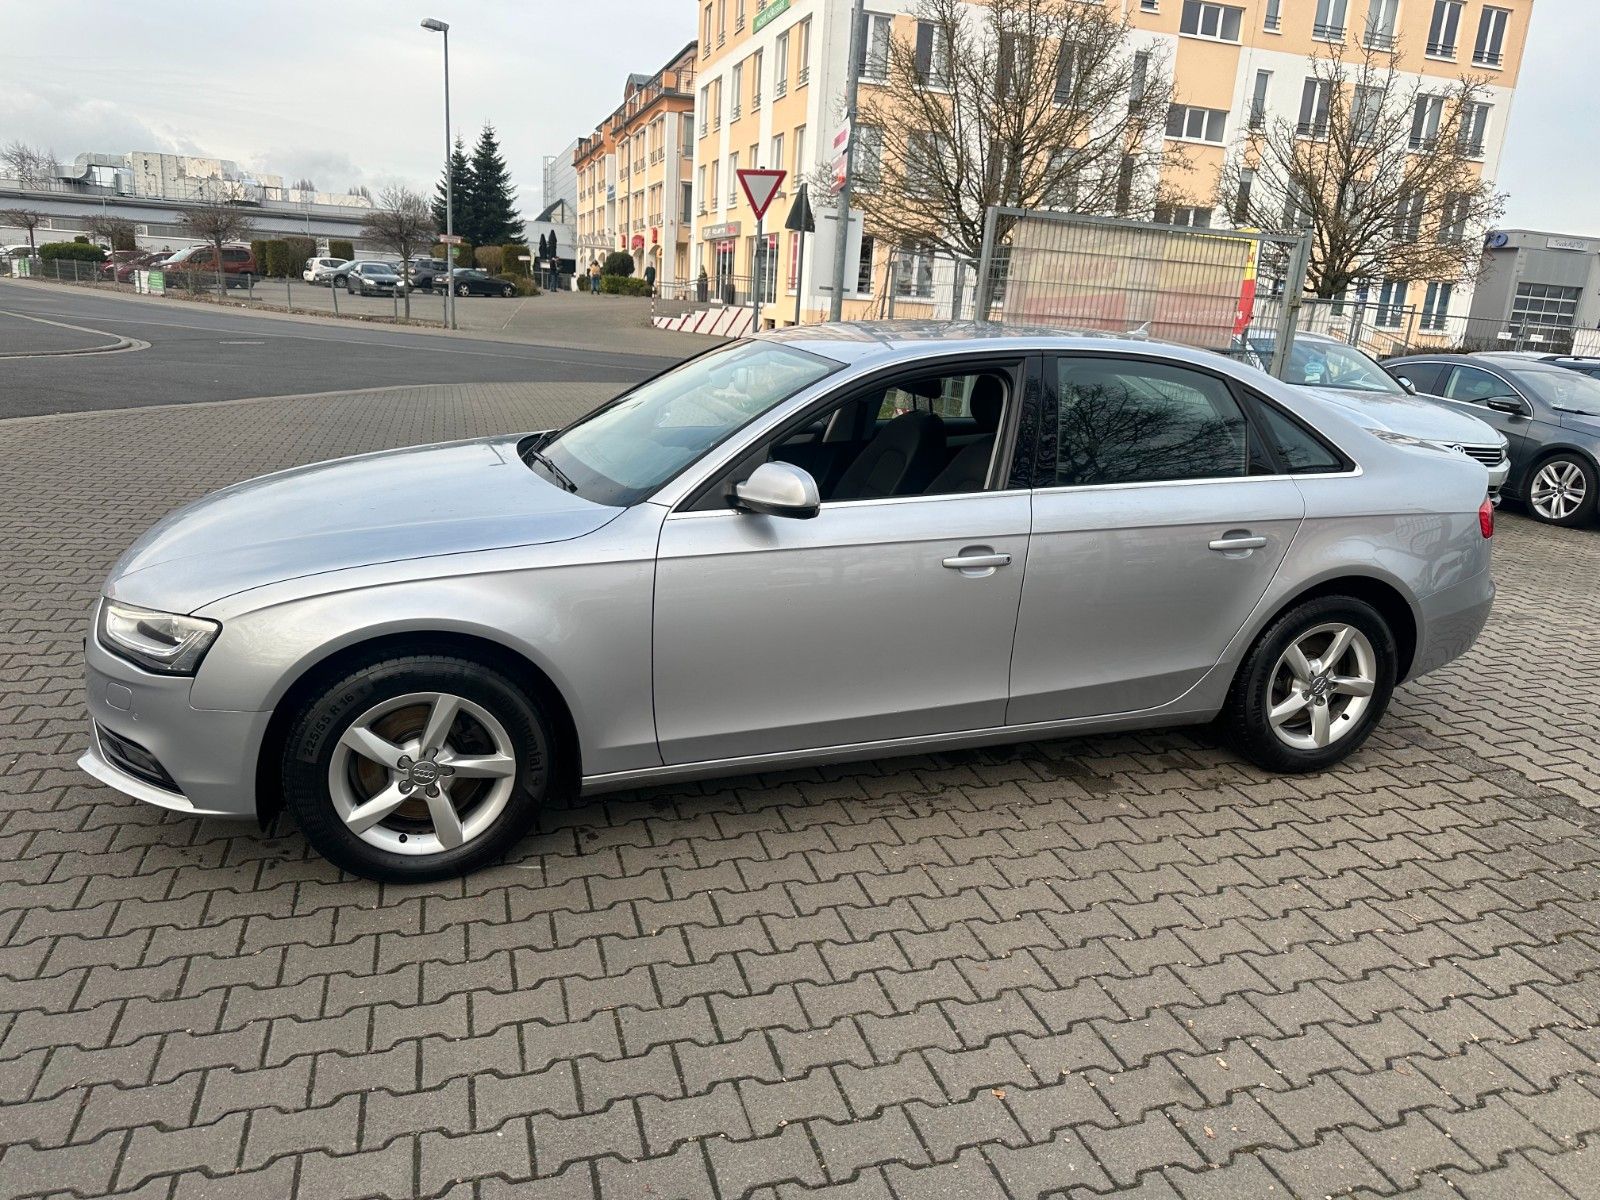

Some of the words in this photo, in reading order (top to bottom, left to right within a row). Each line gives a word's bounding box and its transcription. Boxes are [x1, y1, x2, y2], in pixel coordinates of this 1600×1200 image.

[303, 714, 330, 756] 225/55
[329, 704, 341, 716] R
[340, 693, 355, 705] 16
